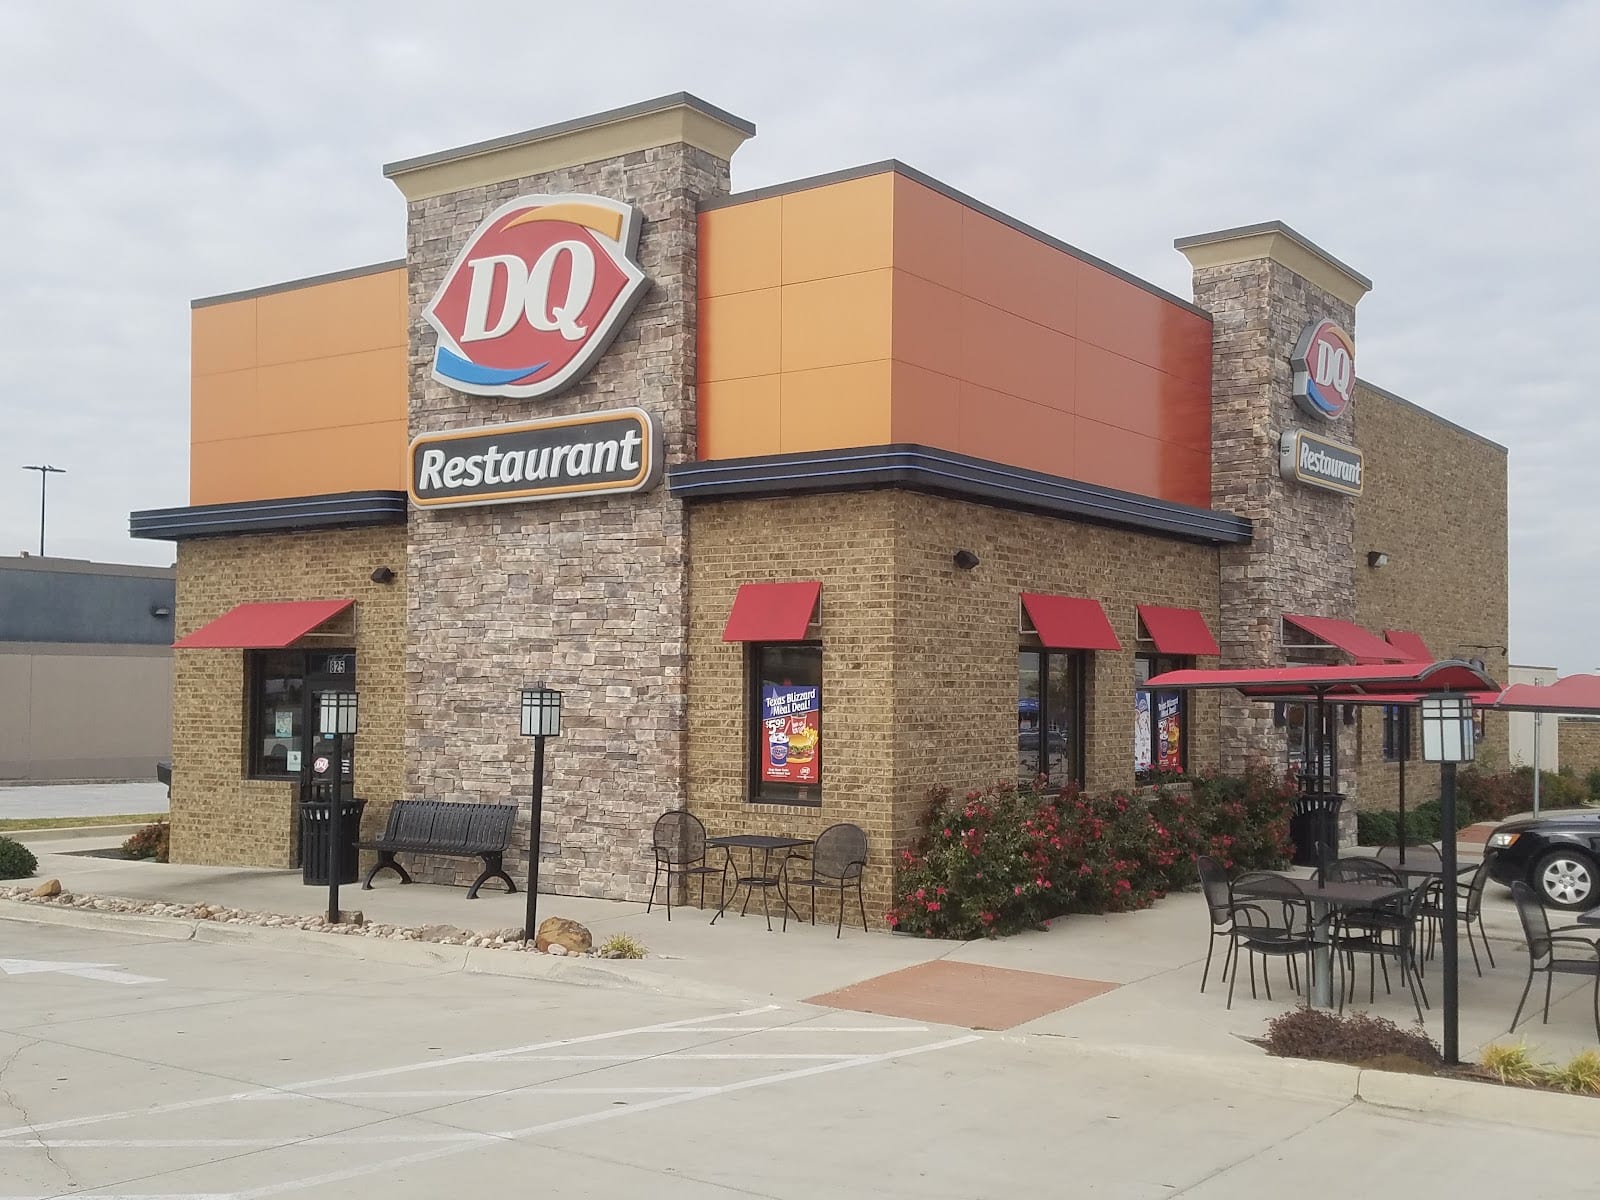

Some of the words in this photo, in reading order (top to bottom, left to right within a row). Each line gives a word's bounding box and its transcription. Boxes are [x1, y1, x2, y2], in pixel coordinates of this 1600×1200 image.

[460, 240, 595, 343] DQ
[1315, 339, 1350, 401] DQ
[418, 429, 643, 490] Restaurant
[1300, 442, 1361, 485] Restaurant
[330, 661, 345, 673] 825
[766, 695, 786, 707] Texas
[786, 689, 815, 703] Blizzard
[773, 703, 791, 716] Meal
[791, 700, 811, 712] Deal!
